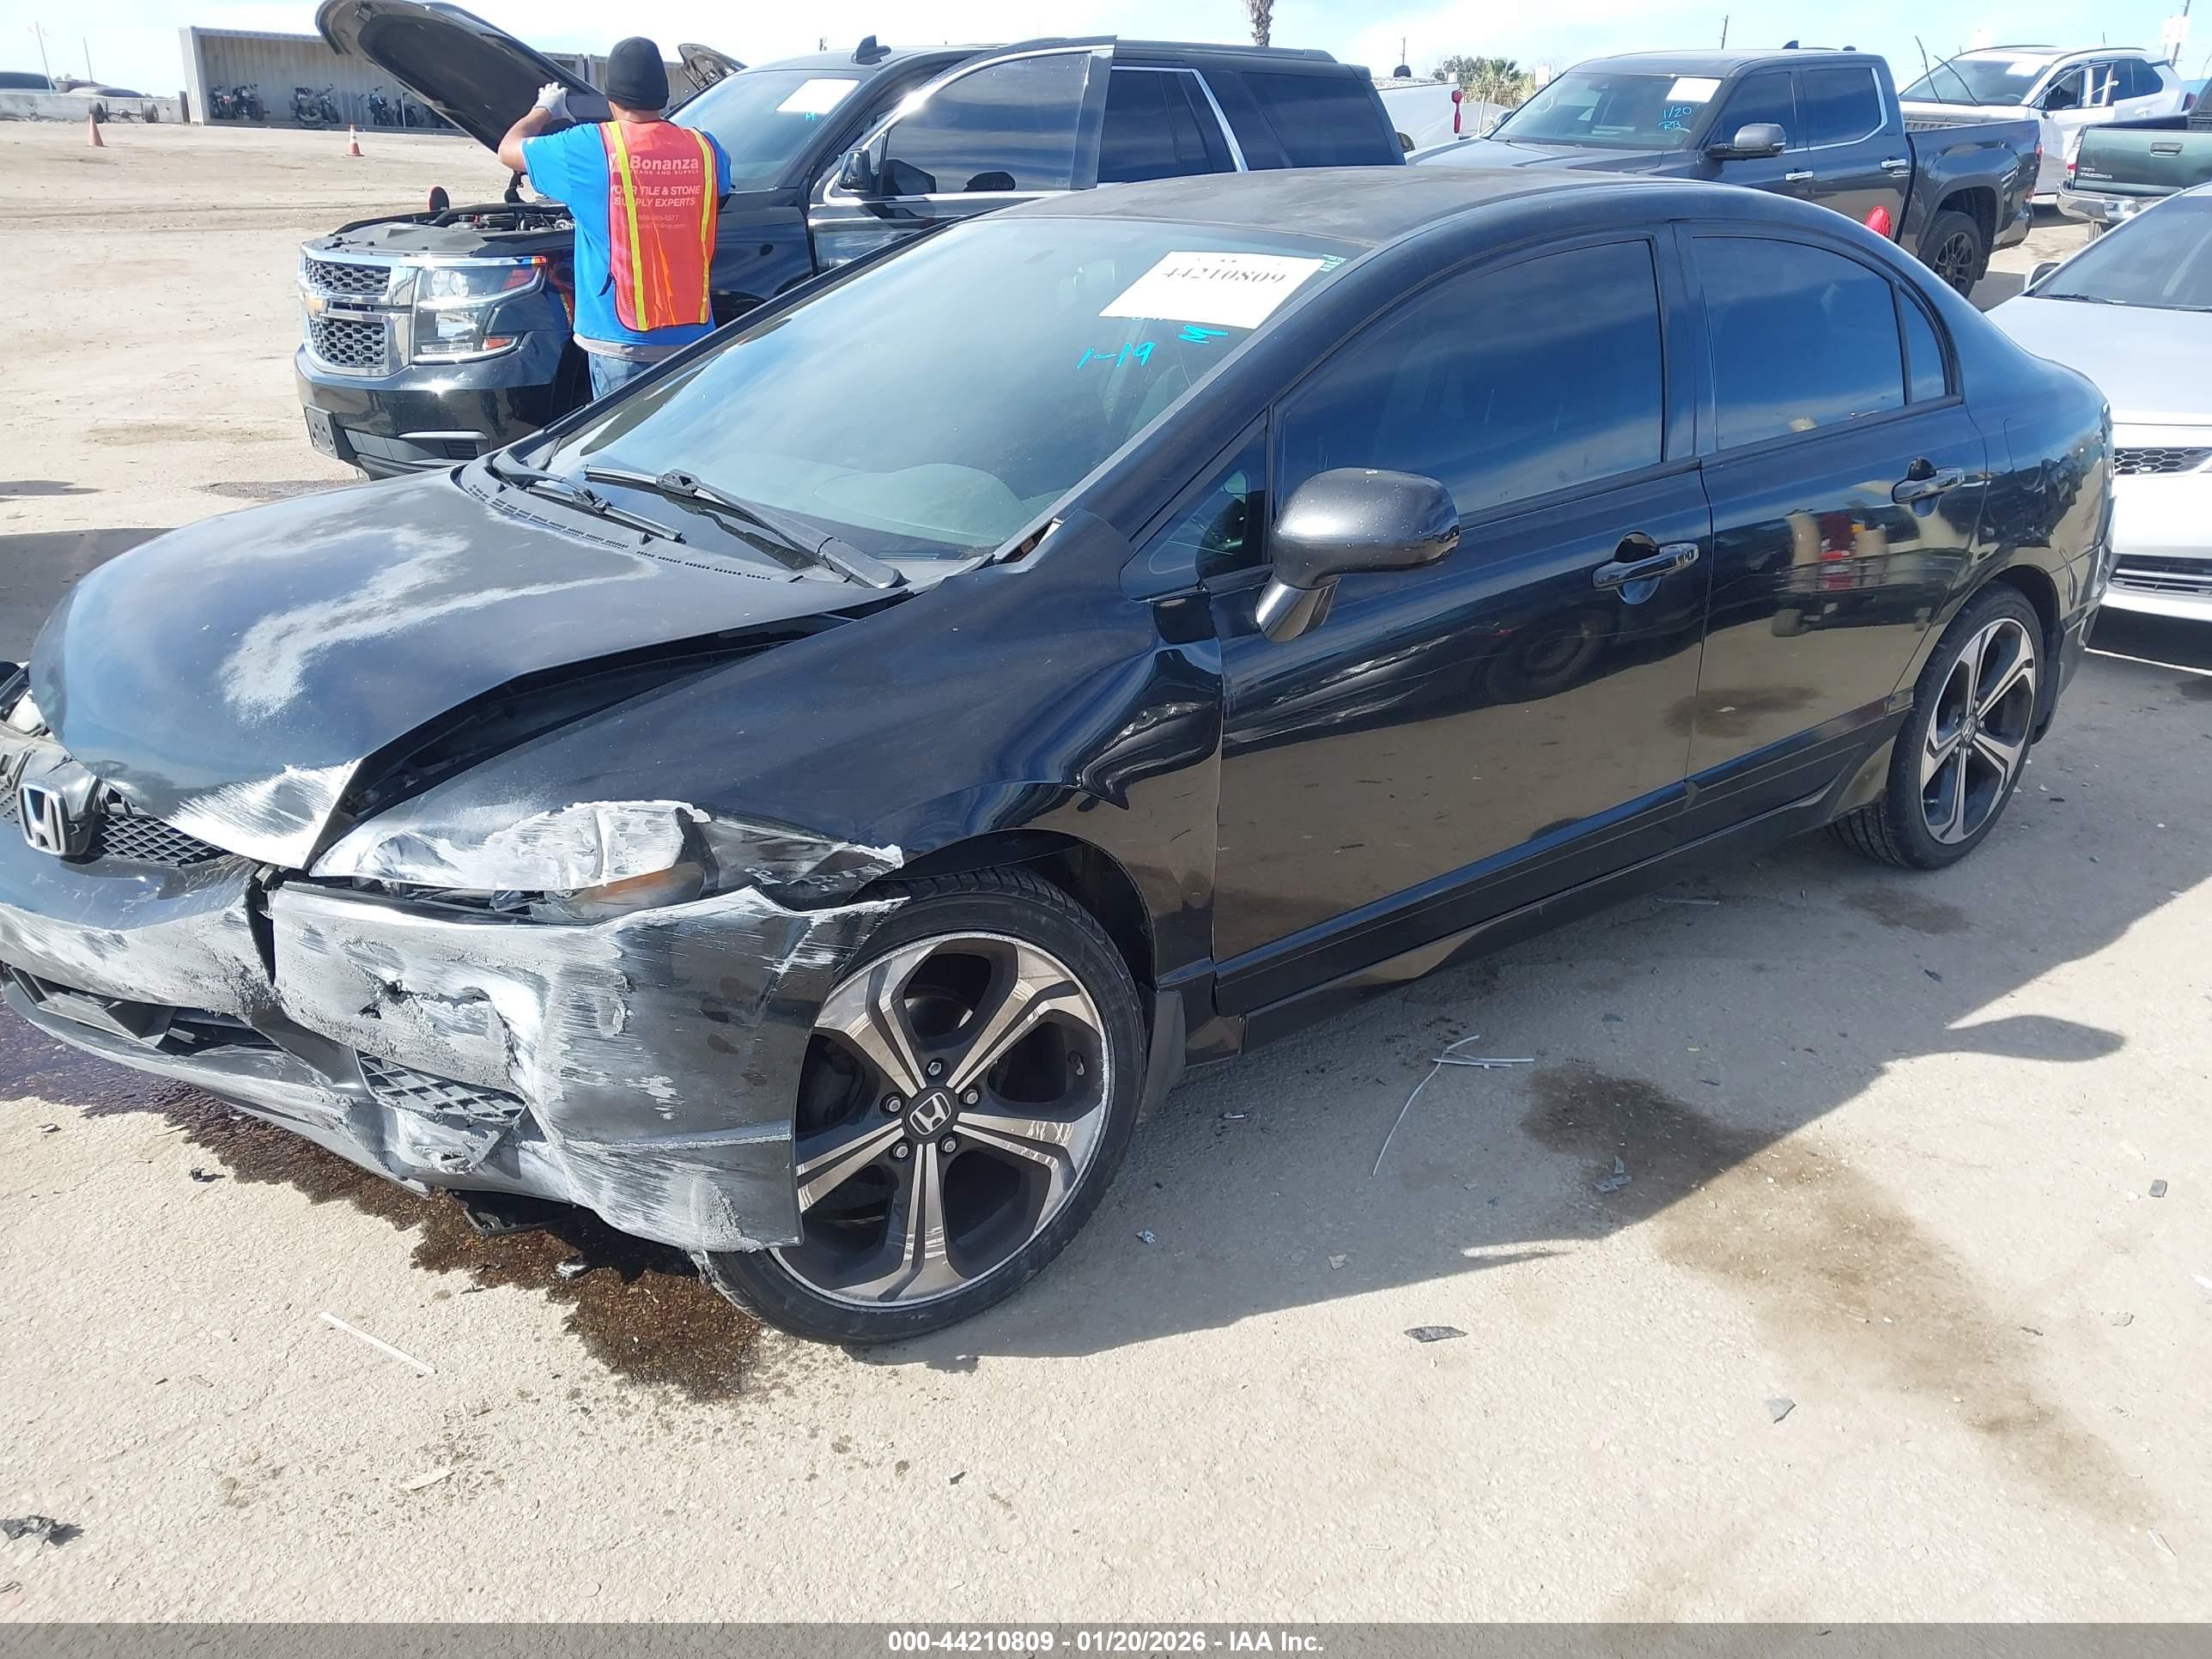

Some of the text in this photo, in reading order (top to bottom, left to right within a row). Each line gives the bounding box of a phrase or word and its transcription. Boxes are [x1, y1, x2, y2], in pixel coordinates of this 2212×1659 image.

[1663, 105, 1692, 118] 1/20
[629, 155, 698, 170] Bonanza
[611, 185, 702, 195] YOR TILE & STONE
[654, 197, 696, 207] EXPERTS
[1162, 268, 1287, 283] 44210809
[1077, 342, 1156, 369] 1-19
